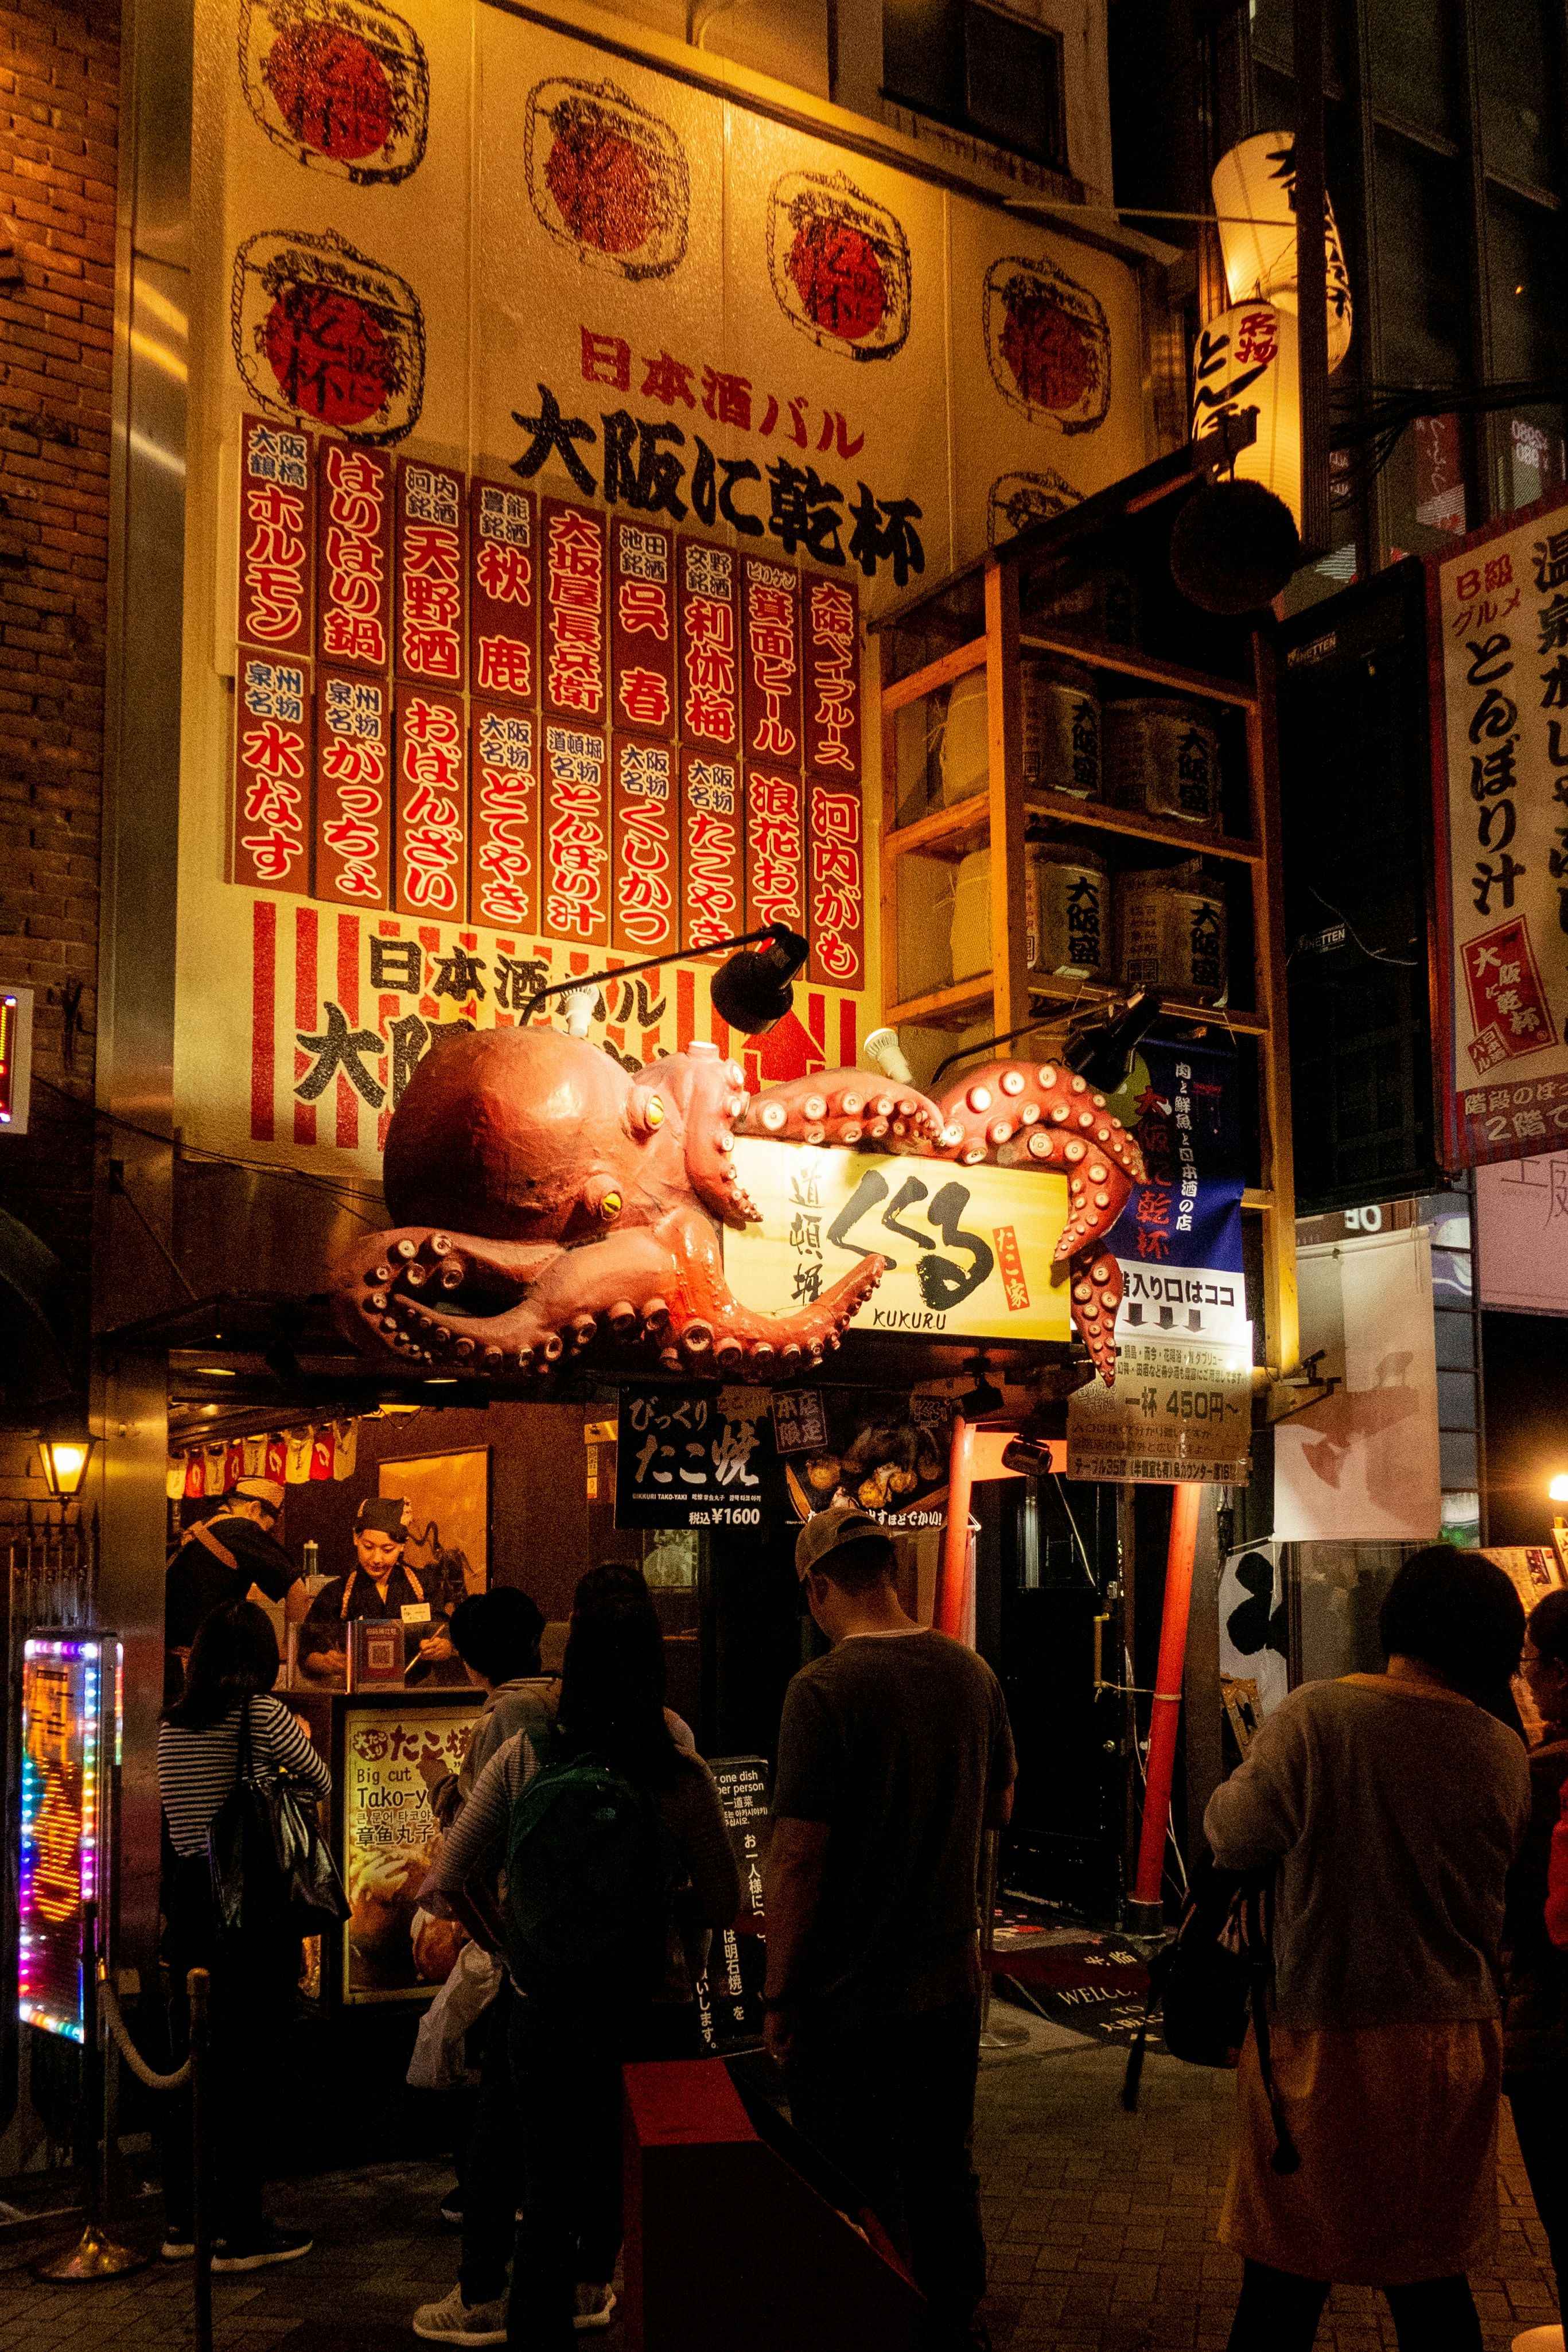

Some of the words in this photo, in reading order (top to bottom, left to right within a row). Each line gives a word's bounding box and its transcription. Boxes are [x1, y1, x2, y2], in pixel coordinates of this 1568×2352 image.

[579, 324, 865, 459] 日本酒バル
[509, 383, 925, 587] 大阪に乾杯
[246, 484, 305, 640] ホルモン
[324, 447, 386, 664] はりはり鍋
[403, 526, 460, 678] 天野酒
[477, 542, 531, 696] 秋鹿
[1452, 586, 1521, 638] グルメ
[245, 689, 302, 724] 名物
[326, 708, 380, 739] 名物
[480, 713, 531, 745] 大阪
[685, 597, 735, 744] 利休梅
[749, 584, 797, 755] 箕面ビール
[812, 581, 855, 771] 大阪ベイブルース
[242, 721, 304, 880] 水なす
[403, 698, 463, 911] おばんざい
[480, 740, 531, 771] 名物
[551, 754, 601, 786] 名物
[620, 771, 669, 800] 名物
[621, 744, 670, 773] 大阪
[688, 760, 734, 788] 大阪
[688, 785, 734, 815] 名物
[1464, 633, 1527, 916] とんぼり汁
[479, 768, 535, 924] どてやき
[547, 780, 608, 936] とんぼり汁
[618, 799, 671, 945] くしかつ
[687, 812, 736, 957] たこやき
[750, 772, 801, 954] 浪花おで
[812, 787, 861, 979] 河内がも
[1175, 1062, 1199, 1232] 肉と鮮魚と日本酒の店
[826, 1169, 995, 1312] くくる
[873, 1308, 946, 1331] KUKURU
[629, 1395, 709, 1432] びっくり
[635, 1418, 760, 1486] たこ焼
[356, 1824, 435, 1846] 章鱼丸子
[357, 1768, 380, 1785] Big
[388, 1767, 412, 1782] cut
[357, 1786, 431, 1809] Tako-y
[398, 1809, 435, 1822] 타코야
[719, 1774, 737, 1784] one
[739, 1770, 758, 1782] dish
[733, 1782, 764, 1797] person
